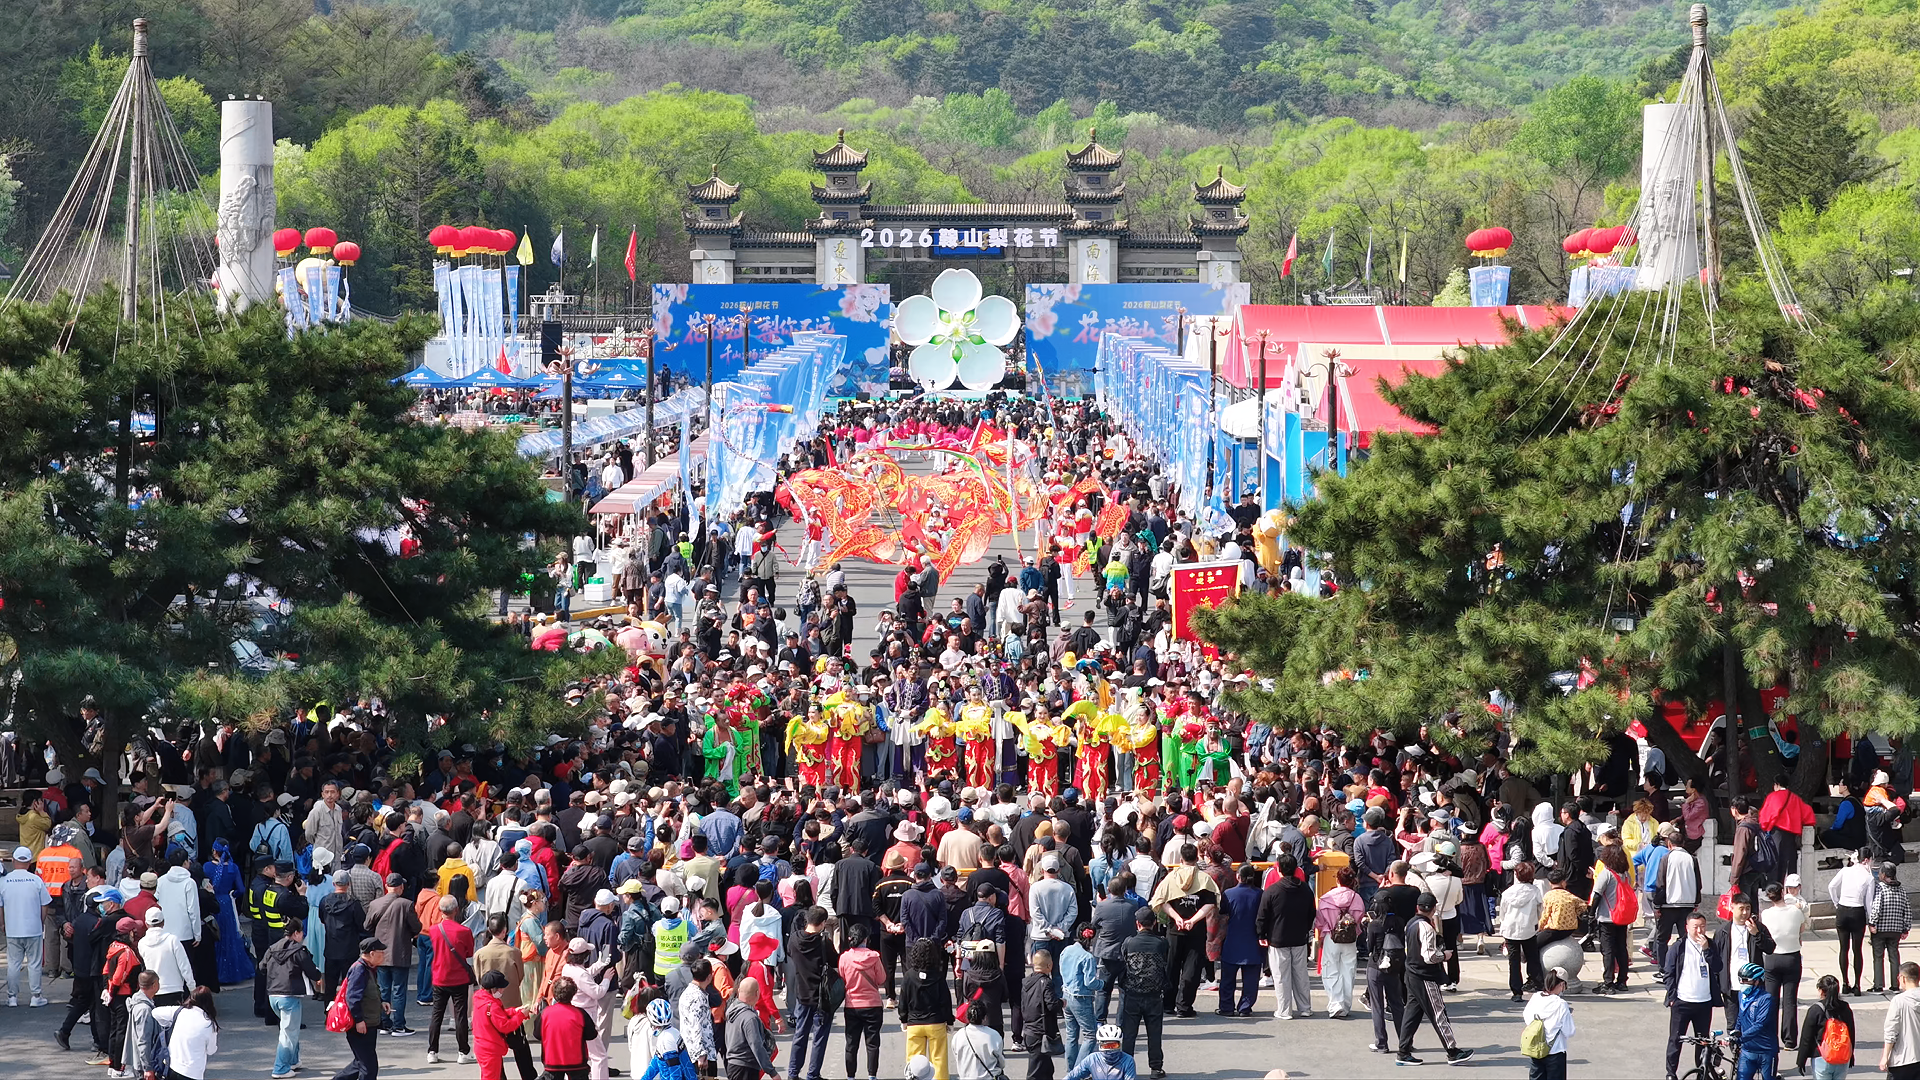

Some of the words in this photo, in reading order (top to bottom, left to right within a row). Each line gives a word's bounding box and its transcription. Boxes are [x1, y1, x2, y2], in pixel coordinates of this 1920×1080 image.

[861, 228, 1058, 248] 2026鞍山梨花节
[1123, 300, 1182, 310] 2026鞍山梨花节
